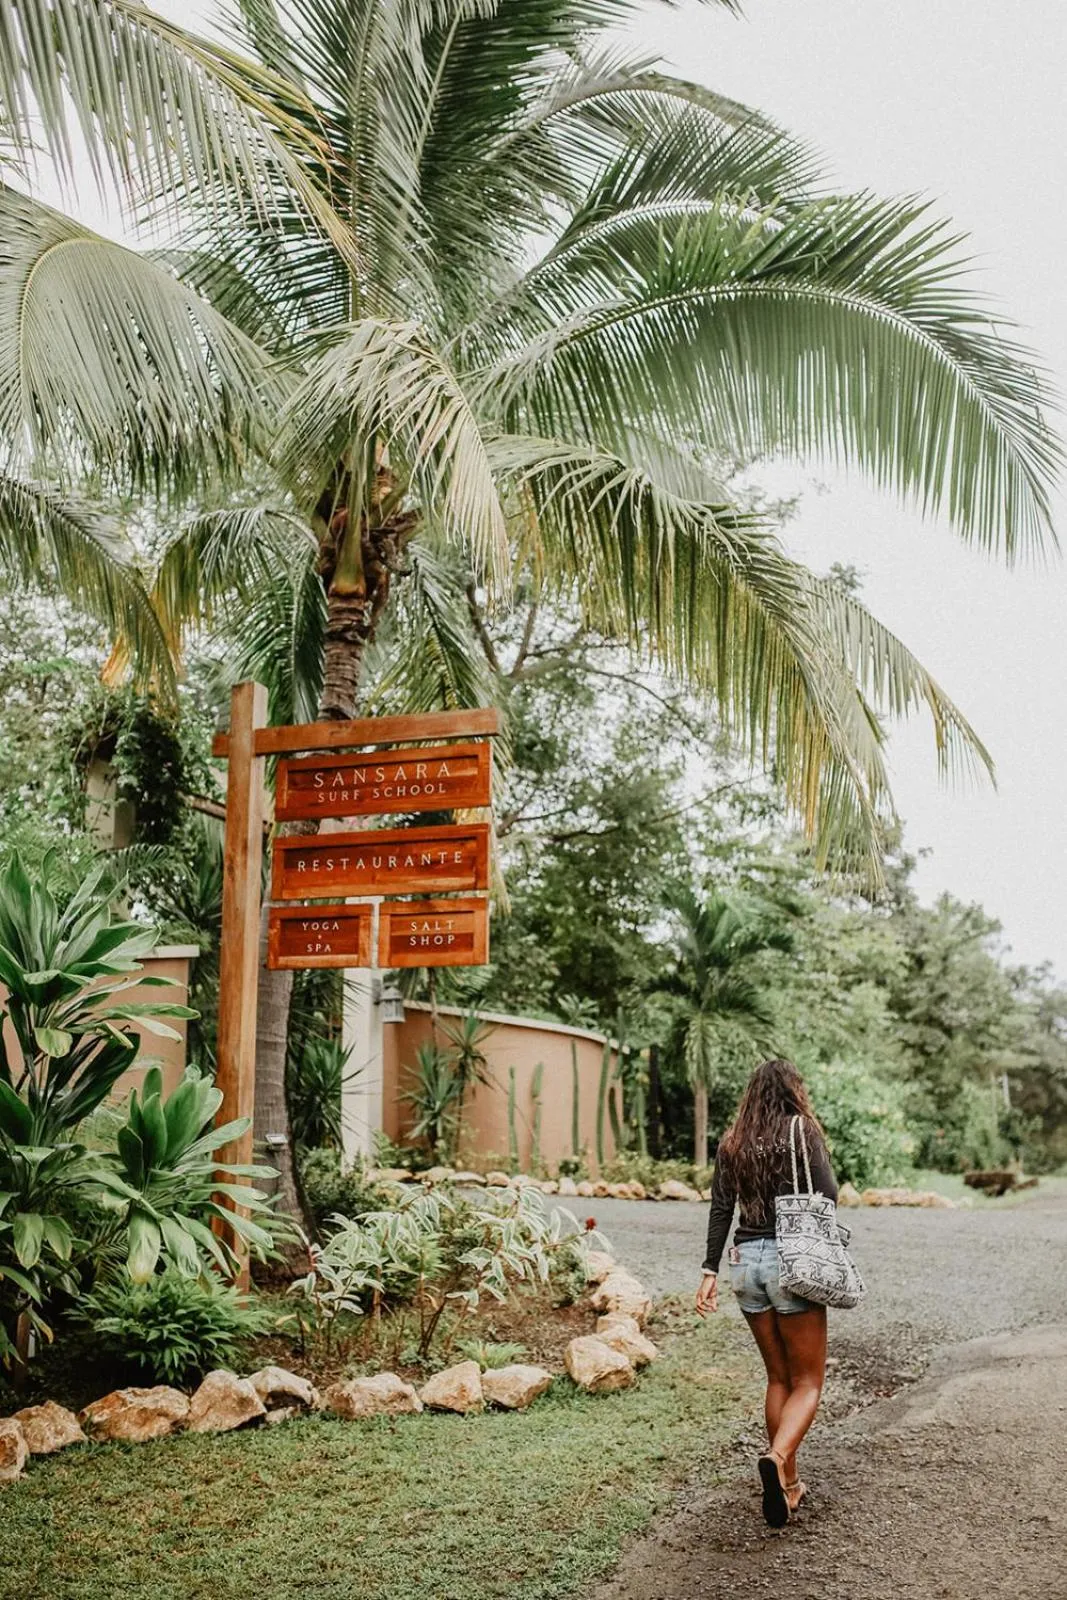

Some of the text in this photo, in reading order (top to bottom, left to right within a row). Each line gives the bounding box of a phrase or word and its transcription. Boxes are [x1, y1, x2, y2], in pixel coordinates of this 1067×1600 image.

[314, 762, 451, 788] SANSARA
[318, 783, 447, 803] SURF SCHOOL
[298, 851, 463, 872] RESTAURANTE
[302, 921, 340, 931] YOGA
[410, 919, 456, 931] SALT
[410, 935, 456, 946] SHOP
[307, 943, 332, 952] SPA
